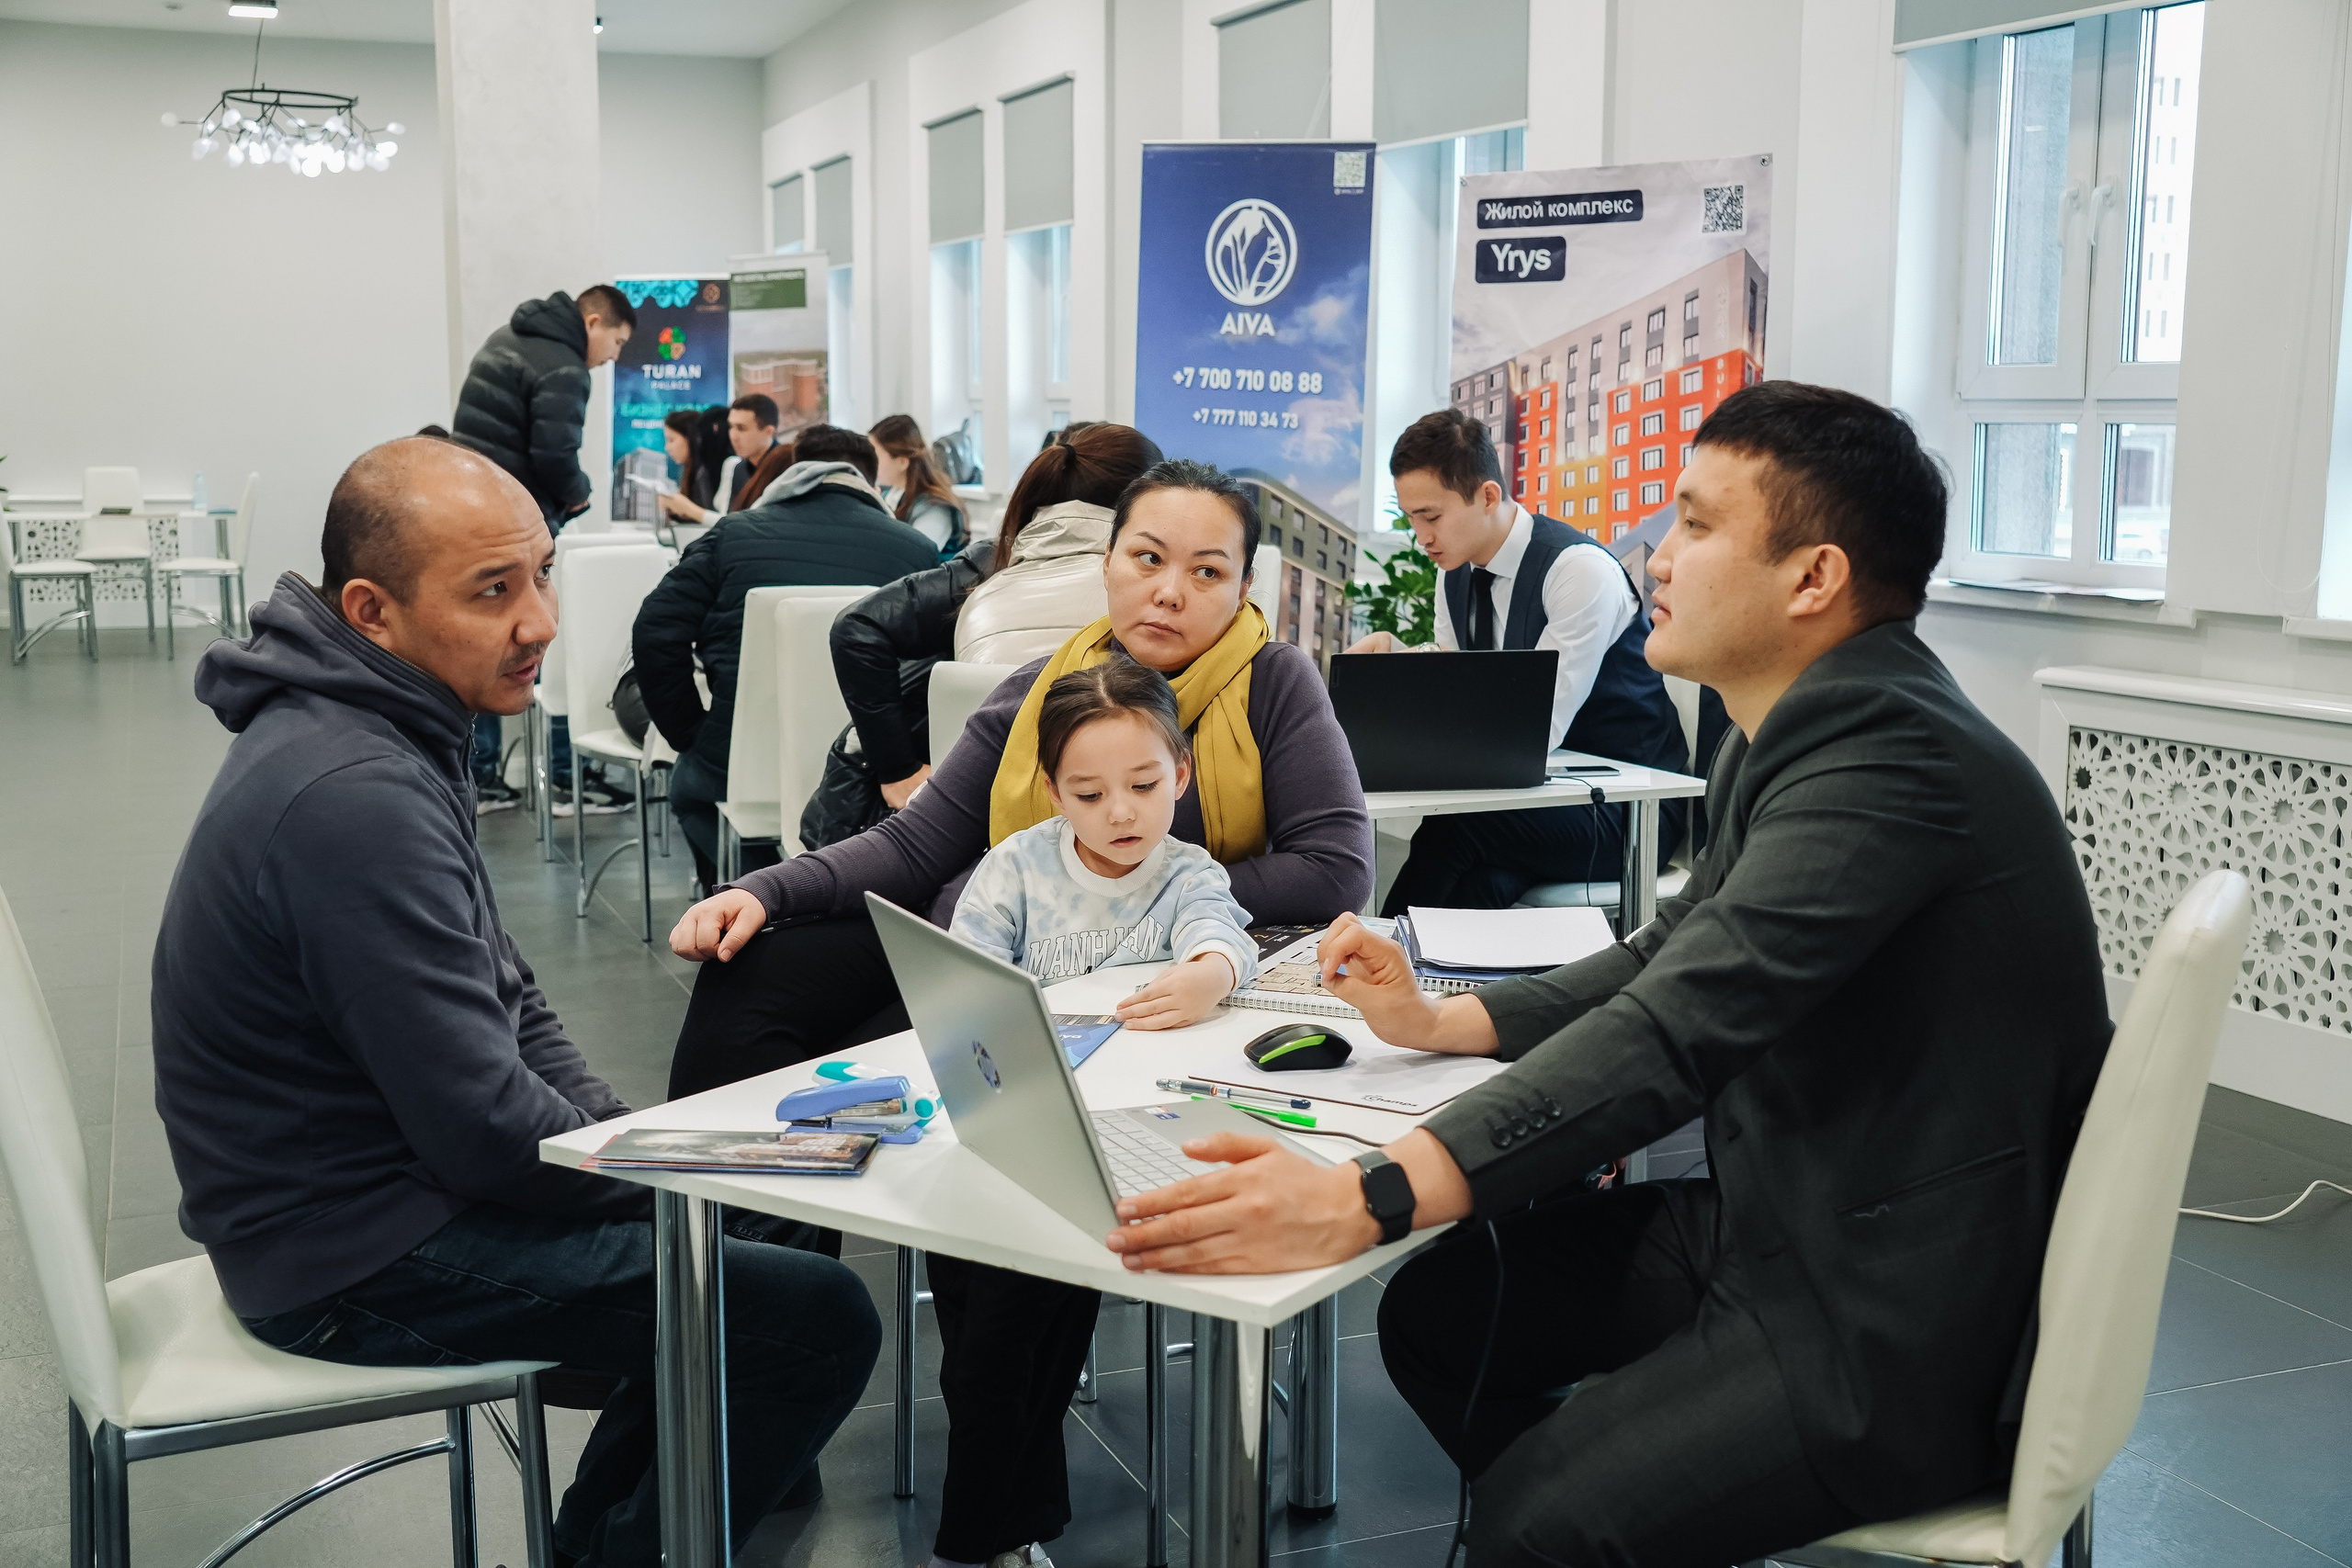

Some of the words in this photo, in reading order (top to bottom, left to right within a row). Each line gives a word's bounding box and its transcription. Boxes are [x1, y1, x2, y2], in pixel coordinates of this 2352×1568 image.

[1485, 200, 1544, 220] Жилой
[1548, 198, 1634, 217] комплекс
[1491, 243, 1552, 278] Yrys
[1220, 311, 1275, 336] AIVA
[641, 364, 702, 379] TURAN
[1172, 367, 1194, 388] +7
[1199, 367, 1231, 389] 700
[1236, 369, 1264, 391] 710
[1270, 370, 1294, 392] 08
[1298, 371, 1323, 393] 88
[1716, 357, 1725, 399] BUI
[1193, 408, 1209, 424] +7
[1212, 409, 1236, 425] 777
[1238, 410, 1257, 427] 110
[1260, 411, 1278, 428] 34
[1282, 412, 1299, 429] 73
[1028, 915, 1164, 981] MANHAN
